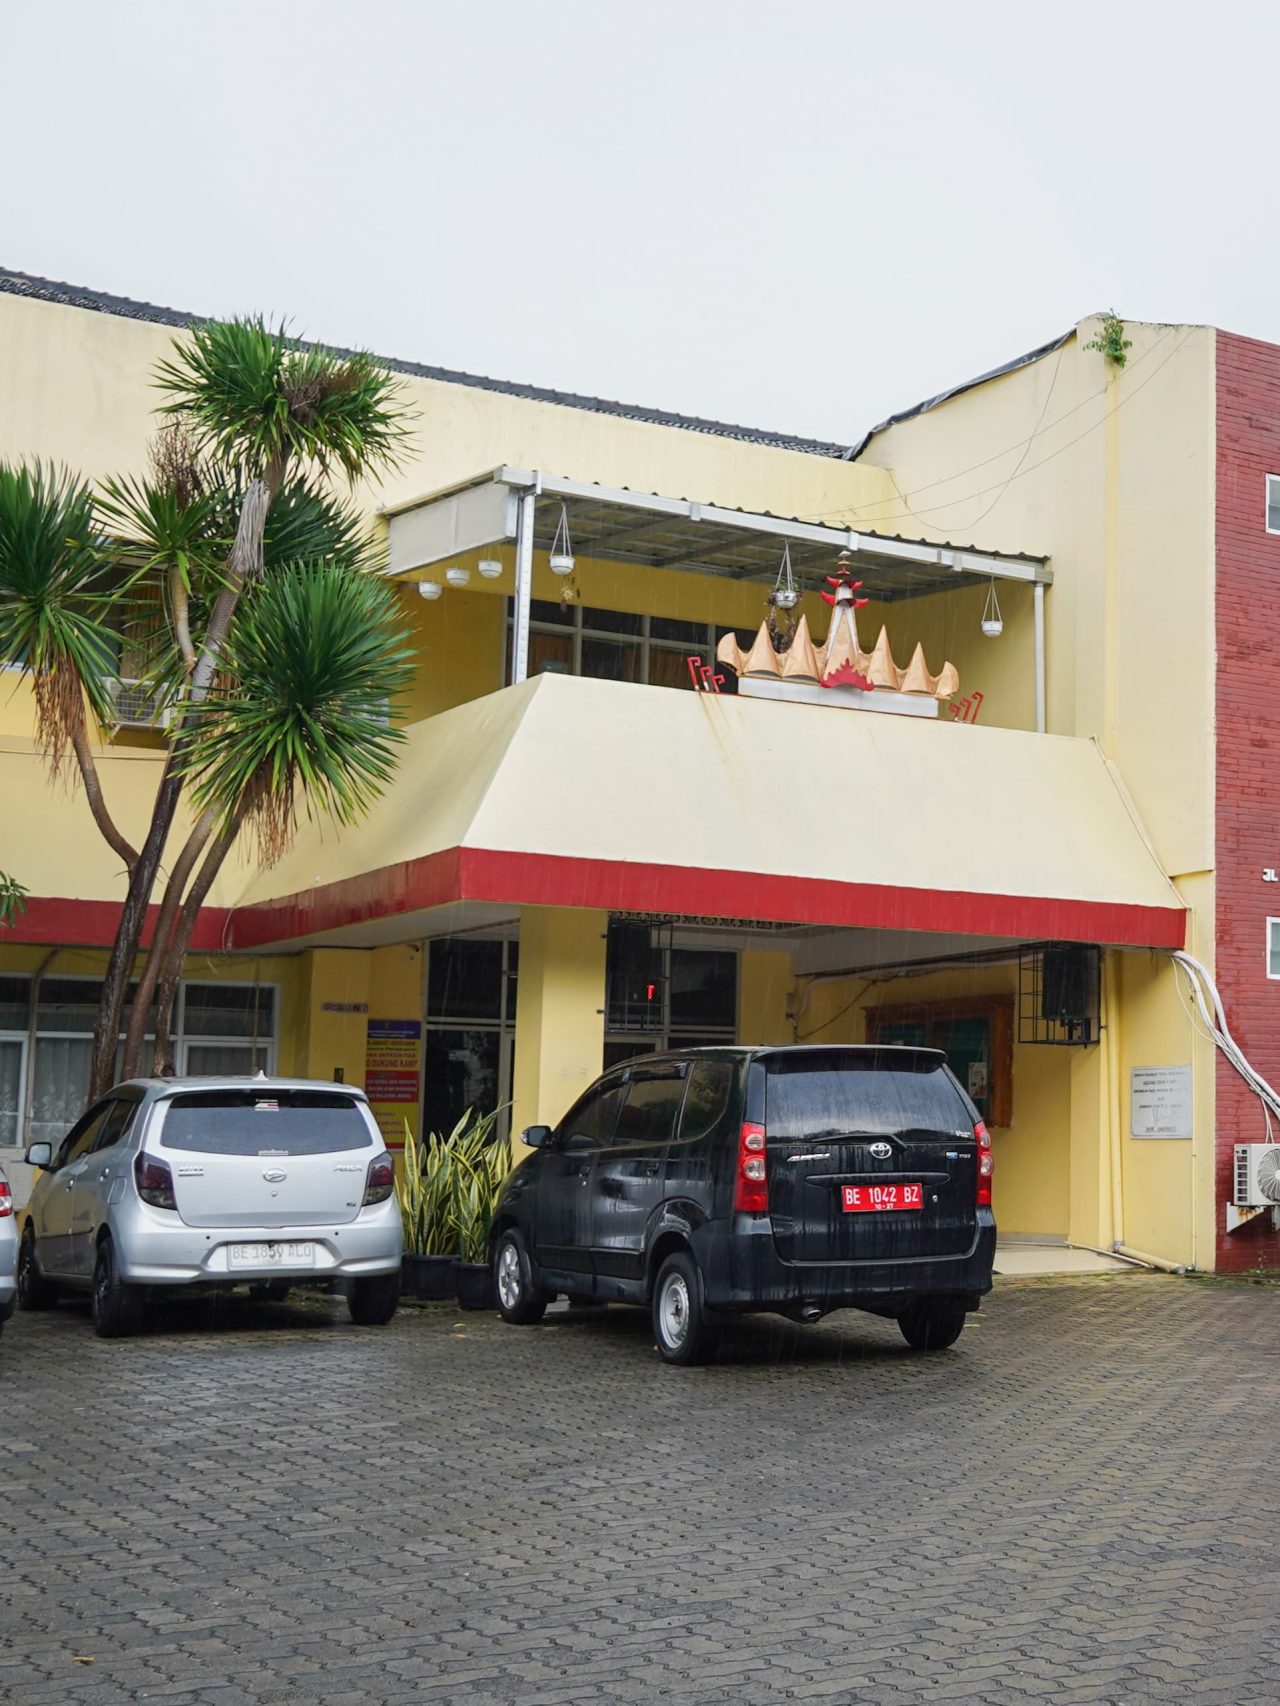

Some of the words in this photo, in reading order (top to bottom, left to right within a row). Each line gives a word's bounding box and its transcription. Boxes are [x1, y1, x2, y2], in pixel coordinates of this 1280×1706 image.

[1262, 868, 1279, 882] JL
[845, 1188, 861, 1205] BE
[868, 1187, 897, 1203] 1042
[903, 1186, 919, 1203] BZ
[232, 1246, 249, 1259] BE
